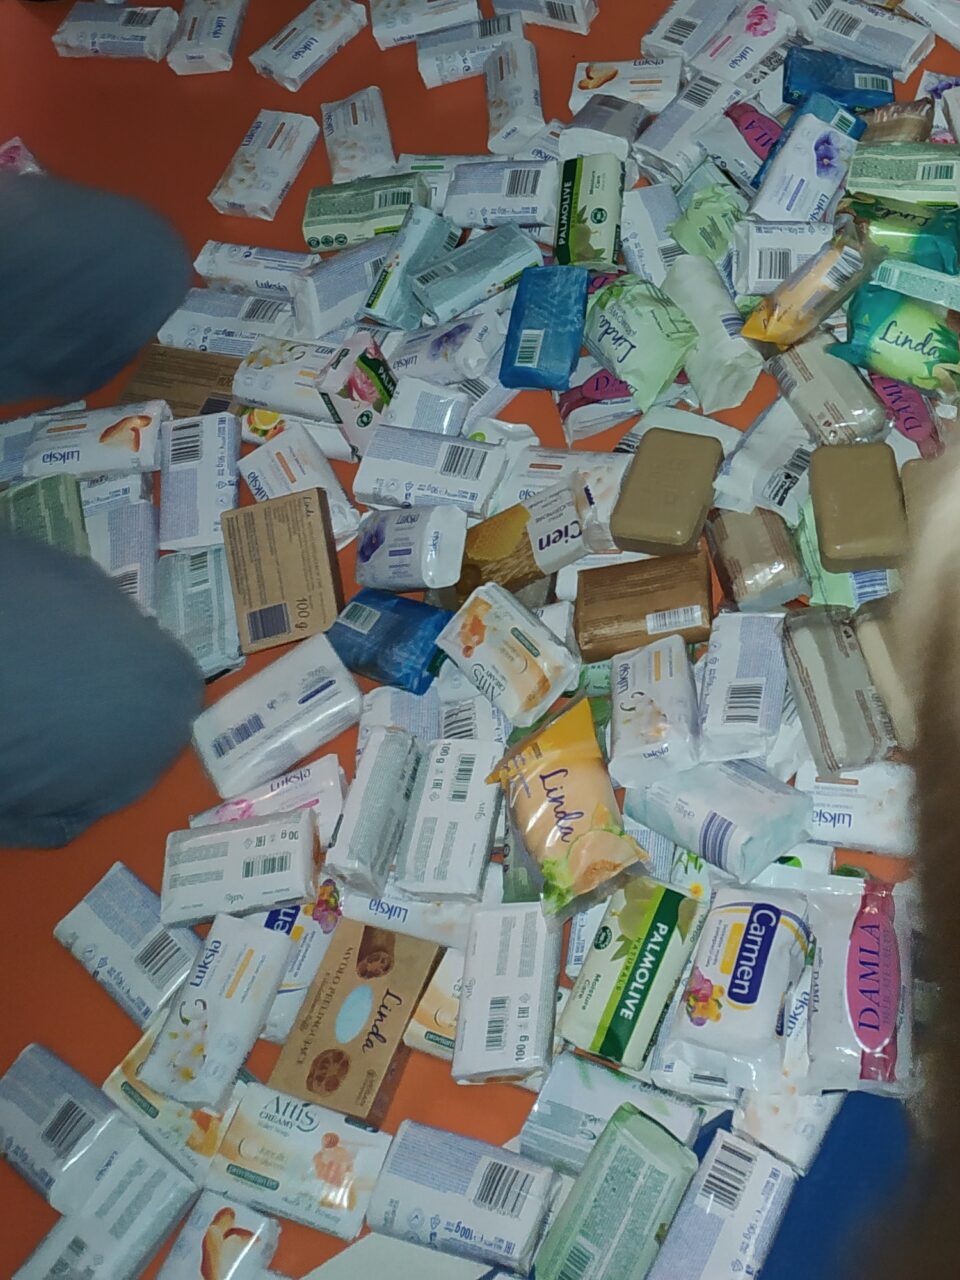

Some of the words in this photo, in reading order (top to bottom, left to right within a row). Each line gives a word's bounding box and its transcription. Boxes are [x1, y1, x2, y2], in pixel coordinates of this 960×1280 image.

[292, 36, 319, 61] Luksja
[730, 46, 754, 69] Luksja
[558, 179, 573, 246] PALMOLIVE
[807, 193, 830, 223] Luksja
[255, 280, 288, 292] Luksja
[599, 314, 637, 364] Linda
[879, 320, 939, 358] Linda
[393, 355, 418, 369] Luksja
[378, 367, 397, 395] PALM
[42, 449, 80, 465] Luksja
[538, 520, 583, 551] Cien
[297, 598, 310, 619] 100
[618, 662, 630, 695] Luksja
[438, 742, 451, 757] 100
[643, 745, 669, 760] Luksja
[271, 768, 311, 793] Luksja
[540, 768, 585, 843] Linda
[369, 898, 409, 924] Luksja
[190, 939, 222, 987] Luksja
[615, 935, 644, 992] NATURALS
[732, 909, 777, 996] Carmen
[619, 921, 670, 1021] PALMOLIVE
[858, 922, 881, 1033] DAMLA
[577, 978, 592, 1000] Care
[581, 972, 602, 1012] Moisture
[362, 987, 403, 1054] Linda
[786, 991, 811, 1038] Luksja
[515, 1045, 526, 1061] 100
[258, 1111, 294, 1130] CREAMY
[264, 1095, 318, 1128] Attis
